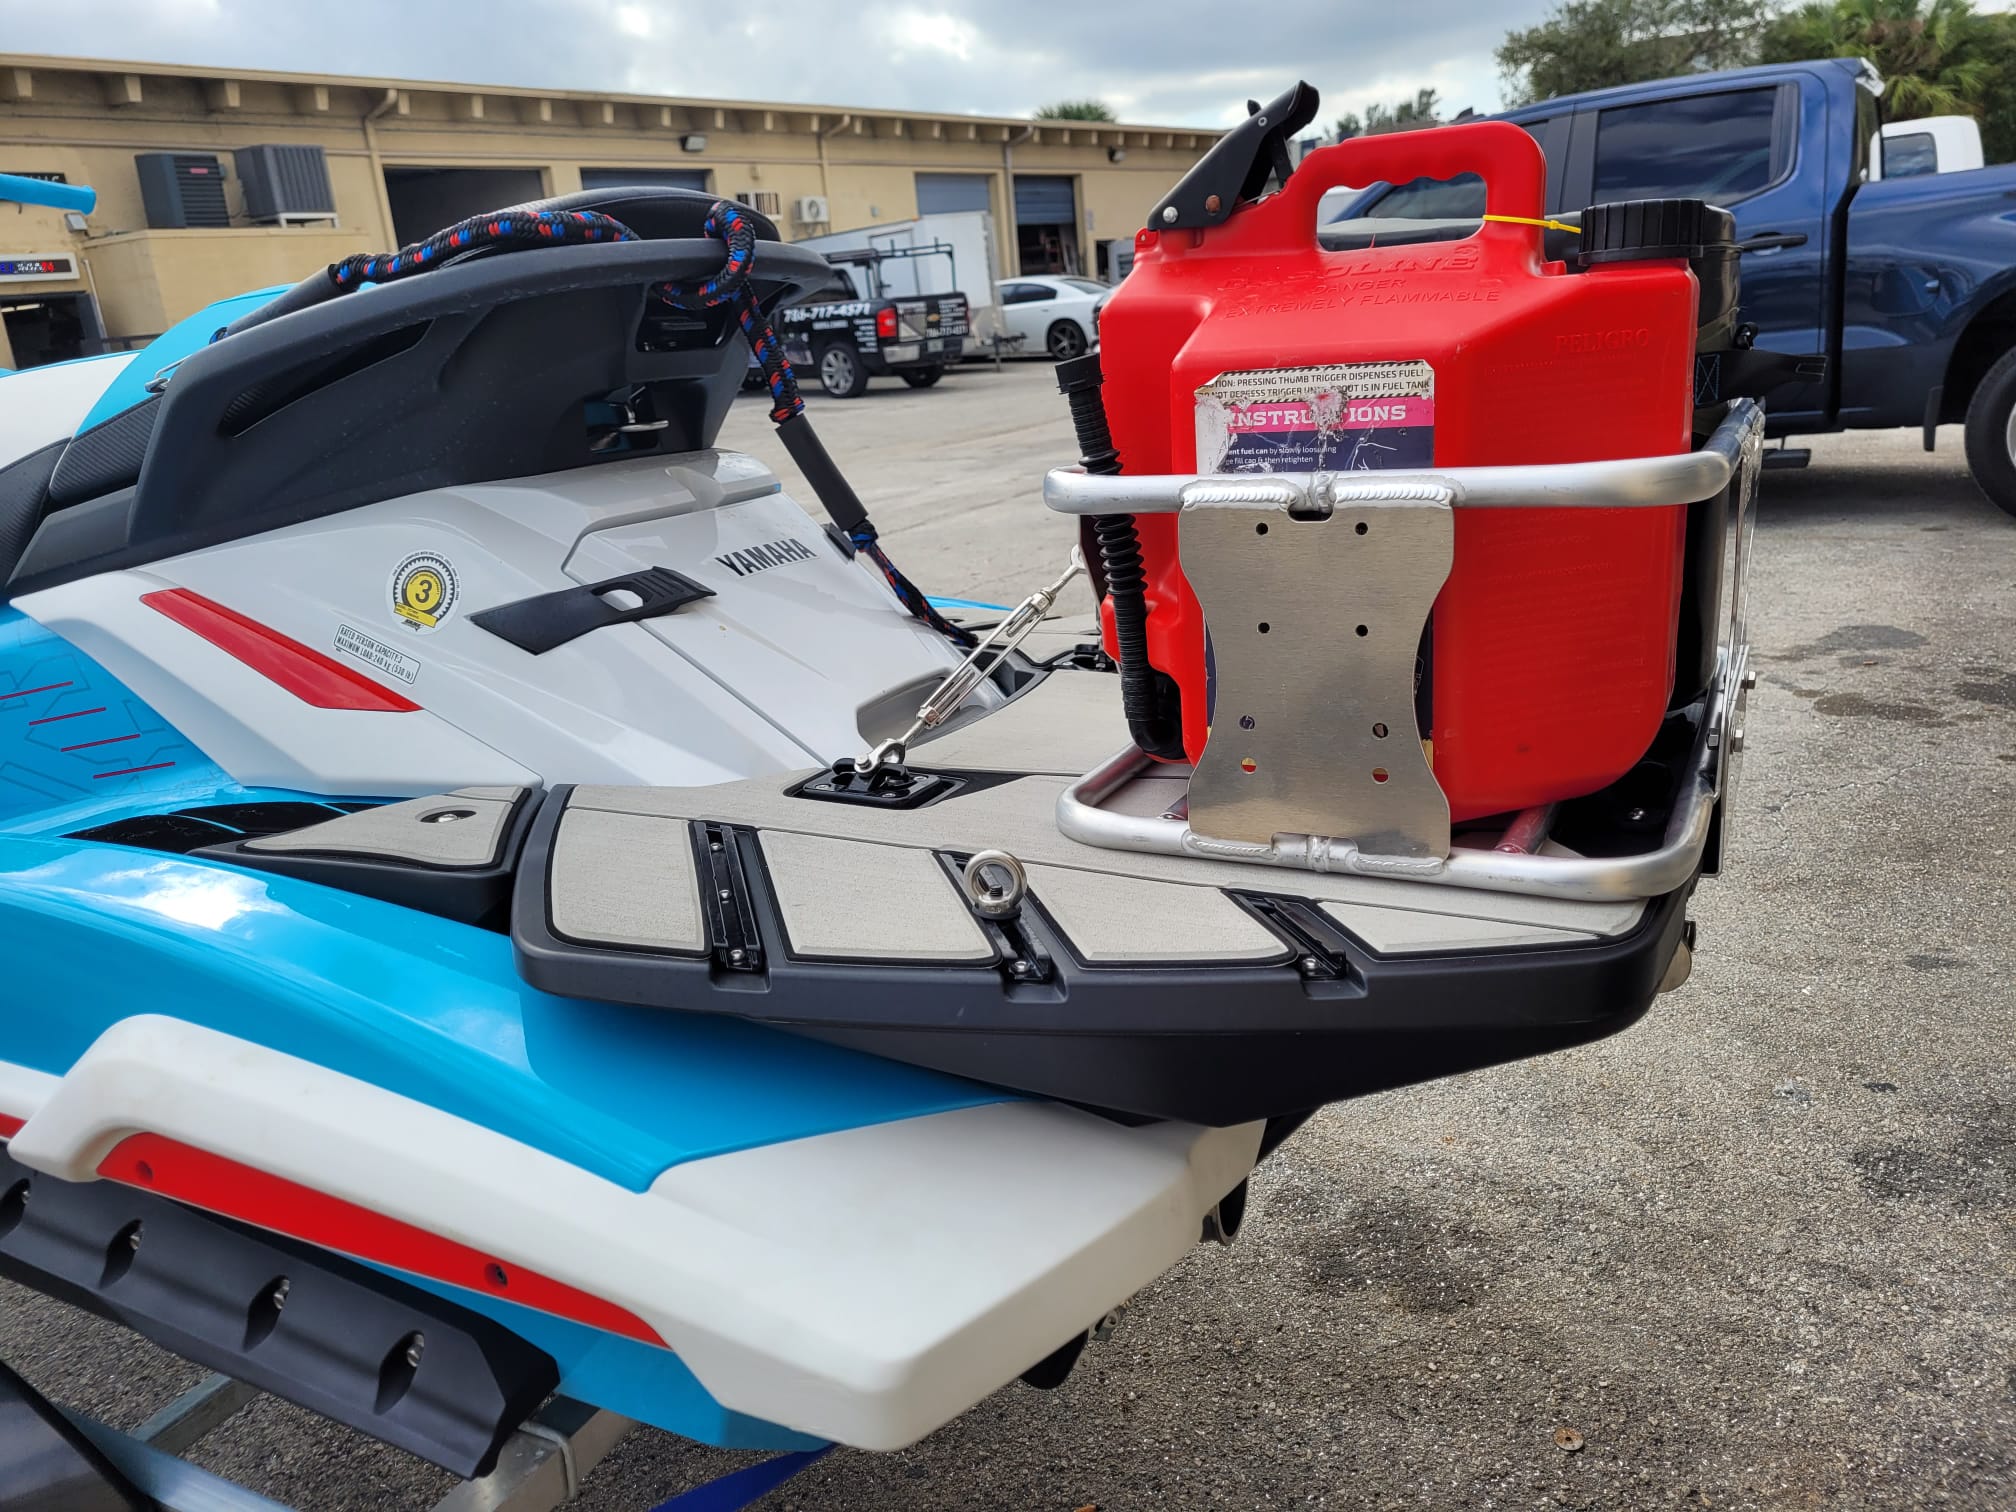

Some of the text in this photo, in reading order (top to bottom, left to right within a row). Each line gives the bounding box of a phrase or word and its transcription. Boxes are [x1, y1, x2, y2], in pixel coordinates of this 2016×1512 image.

[1217, 256, 1478, 291] OLINE
[1312, 279, 1407, 295] DANGER
[1225, 291, 1501, 318] EXTREMELY FLAMMABLE
[1554, 328, 1650, 353] PELIGRO
[1237, 376, 1277, 387] PRESSING
[1279, 375, 1309, 384] THUMB
[1311, 374, 1347, 383] TRIGGER
[1349, 370, 1397, 381] DISPENSES
[1398, 369, 1424, 378] FUEL!
[1267, 387, 1302, 397] TRIGGER
[1361, 383, 1369, 392] IS
[1371, 383, 1380, 391] IN
[1383, 382, 1404, 390] FUEL
[1406, 380, 1430, 389] TANK
[1230, 405, 1406, 428] INSTRUIONS
[1234, 457, 1244, 465] fill
[1281, 456, 1313, 465] retighten
[1241, 447, 1255, 455] fuel
[1269, 447, 1277, 456] by
[1279, 446, 1301, 456] slowly
[715, 539, 817, 576] YAMAHA
[415, 579, 433, 603] 3
[337, 635, 360, 654] MAXIMUM
[384, 660, 391, 671] kg
[392, 663, 405, 676] (530
[340, 626, 403, 664] RATED PERSON CAPACITY:3
